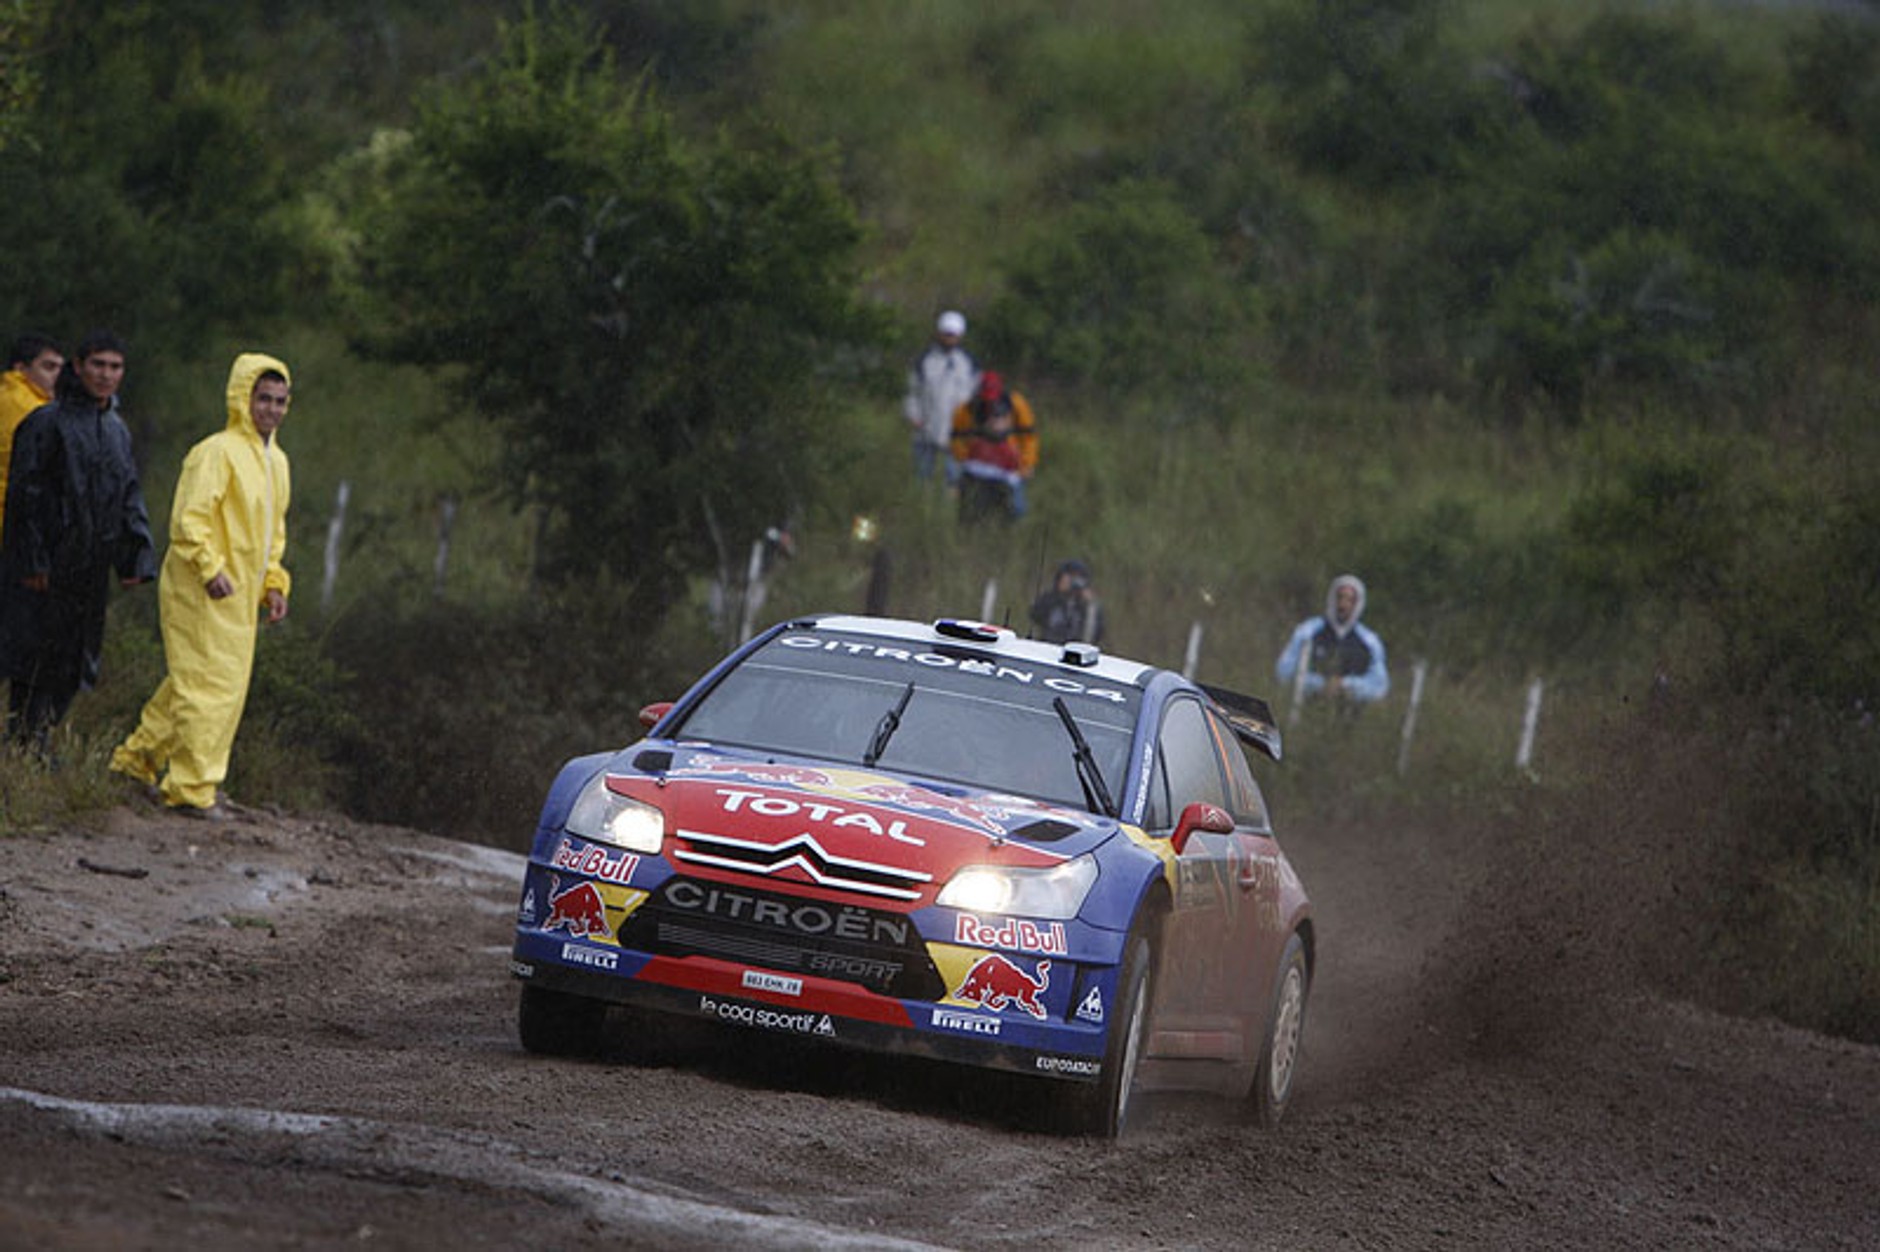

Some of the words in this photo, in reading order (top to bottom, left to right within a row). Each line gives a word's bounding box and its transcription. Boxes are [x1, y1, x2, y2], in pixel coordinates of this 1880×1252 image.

[781, 636, 1033, 683] CITROËN
[1044, 677, 1126, 702] C4
[716, 788, 926, 846] TOTAL
[581, 847, 640, 884] Bull
[665, 881, 908, 945] CITROËN
[954, 912, 1017, 950] Red
[1017, 919, 1068, 954] Bull
[562, 942, 619, 970] PIRELLI
[809, 952, 903, 981] SPORT
[701, 996, 716, 1014] le
[718, 1003, 755, 1025] coq
[756, 1010, 814, 1033] sportif
[931, 1008, 1002, 1036] PIRELLI
